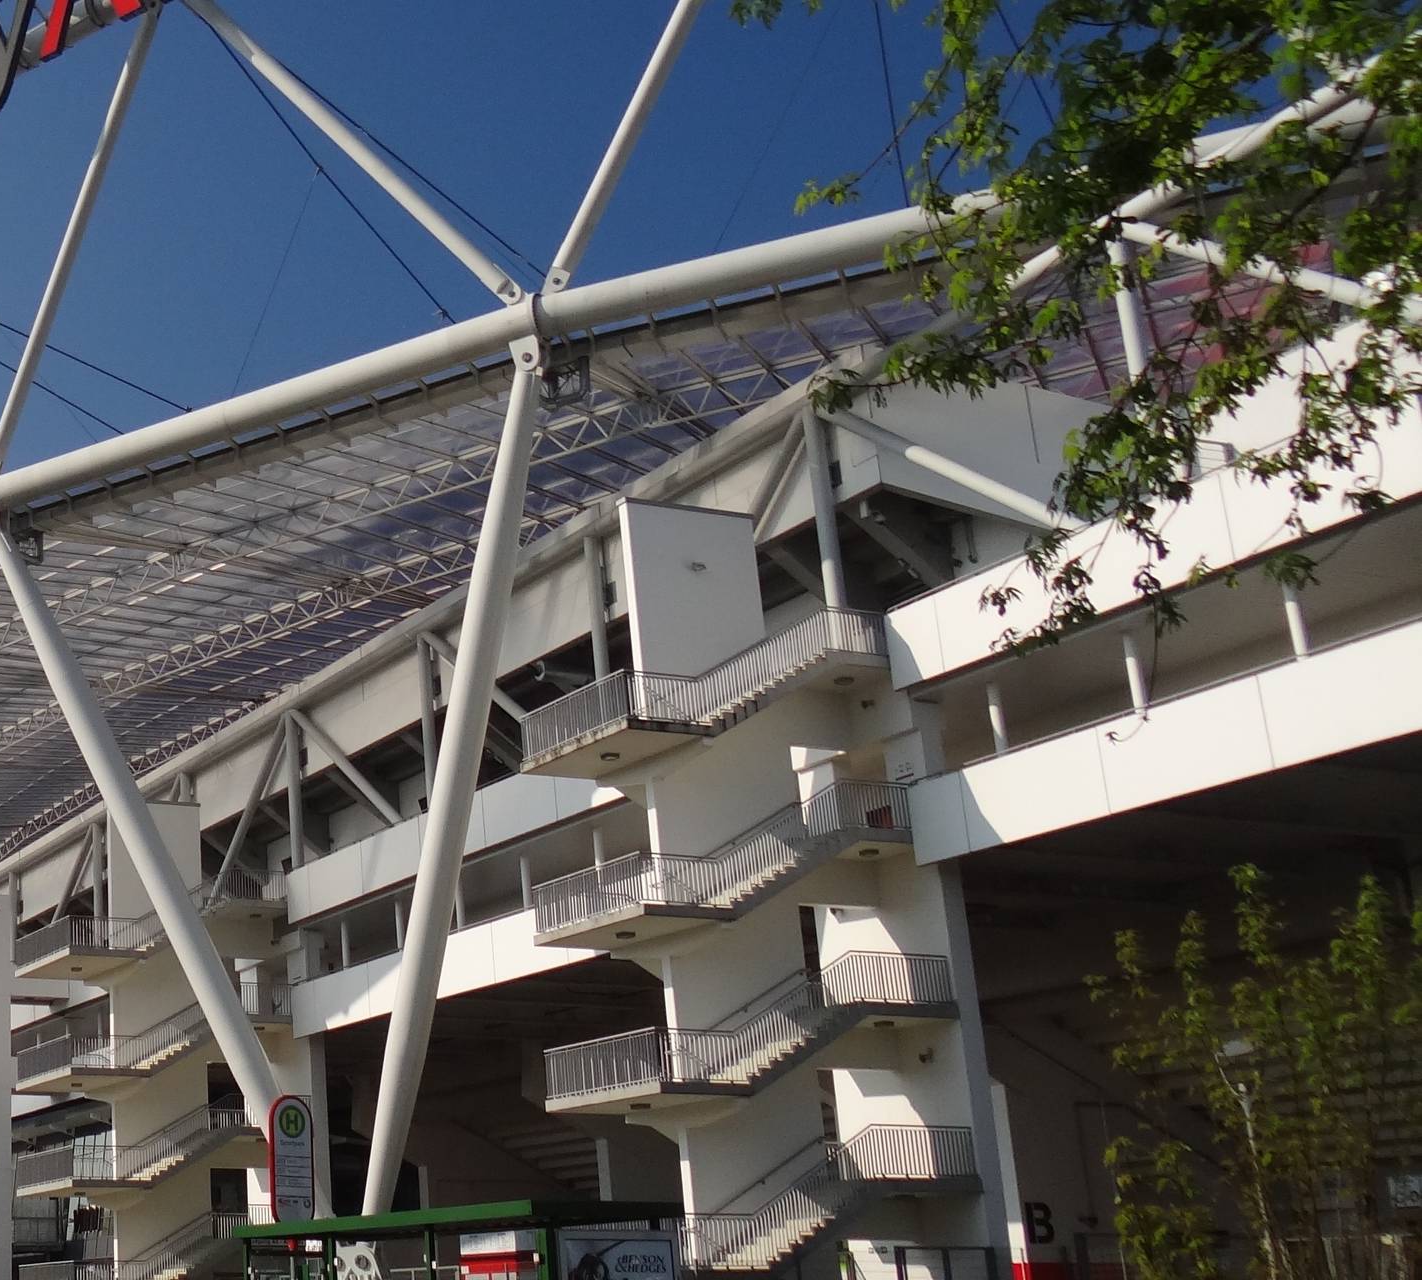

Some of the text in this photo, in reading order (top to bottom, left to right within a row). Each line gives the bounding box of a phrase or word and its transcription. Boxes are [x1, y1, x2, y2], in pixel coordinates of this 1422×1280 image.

[285, 1112, 299, 1131] H
[1024, 1202, 1055, 1244] B
[621, 1254, 665, 1264] BENSON
[627, 1263, 667, 1273] HEDGES
